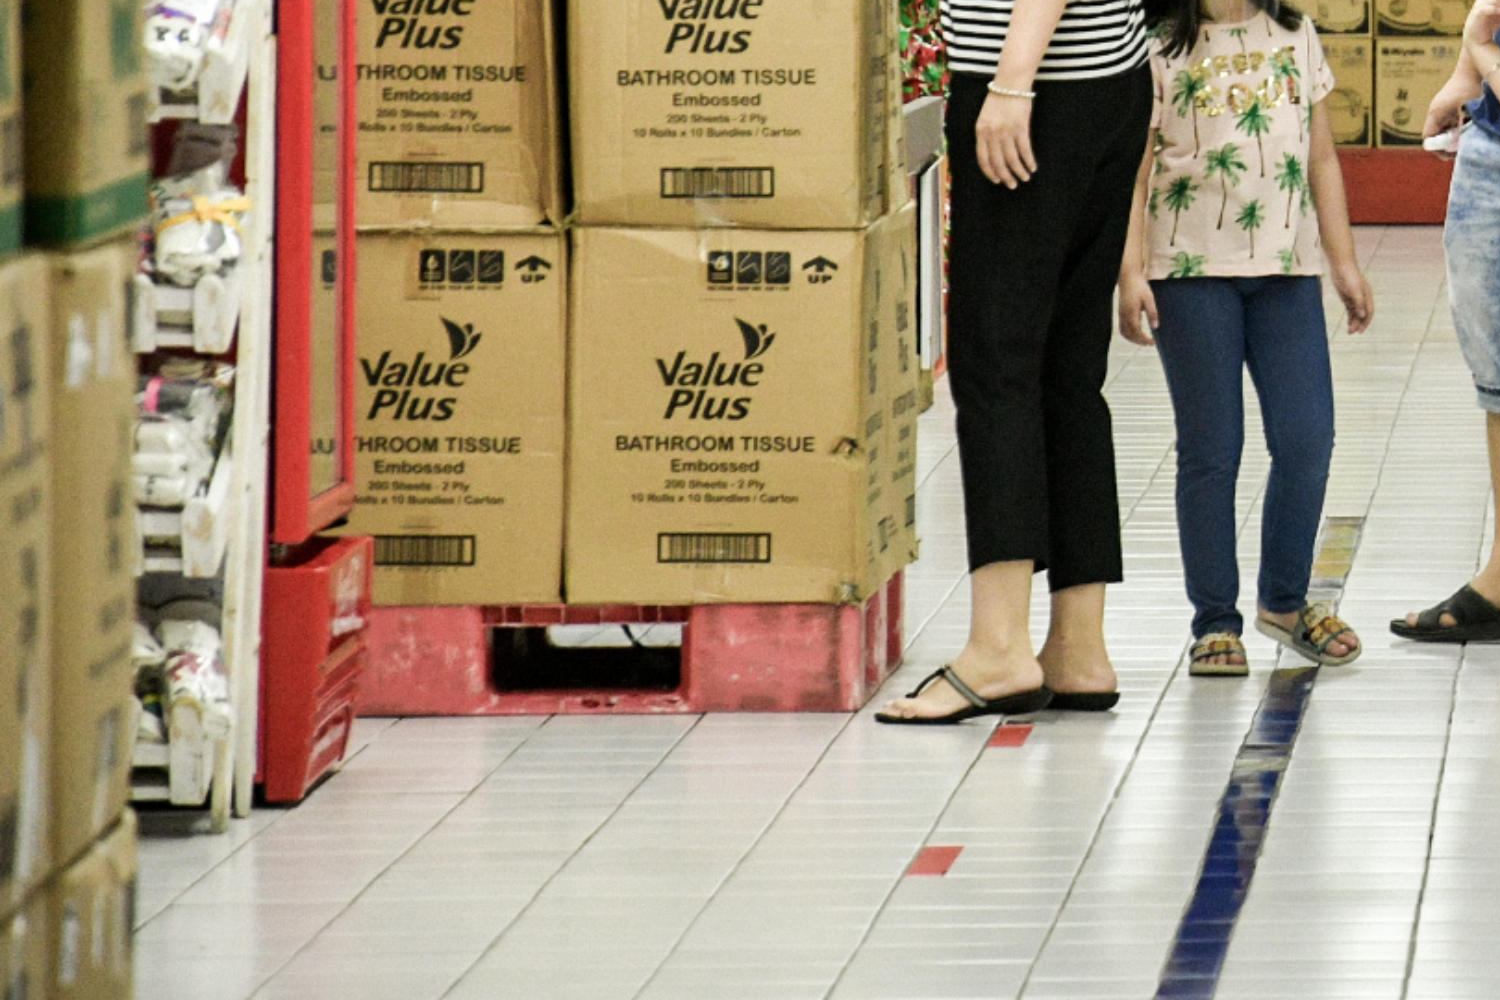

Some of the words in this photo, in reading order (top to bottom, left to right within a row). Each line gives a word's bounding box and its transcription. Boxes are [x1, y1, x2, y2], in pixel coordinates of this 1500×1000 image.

[375, 17, 464, 50] Plus
[664, 22, 752, 54] Plus
[355, 64, 447, 81] THROOM
[452, 65, 527, 82] TISSUE
[617, 69, 736, 87] BATHROOM
[741, 68, 817, 86] TISSUE
[382, 87, 473, 102] Embossed
[672, 92, 762, 107] Embossed
[690, 113, 730, 124] Sheets
[740, 113, 747, 124] 2
[749, 113, 768, 126] Ply
[633, 128, 647, 138] 10
[649, 127, 678, 138] Rolls
[690, 127, 704, 138] 10
[706, 127, 753, 138] Bundles
[762, 126, 801, 137] Carton
[520, 273, 546, 284] UP
[807, 273, 833, 285] UP
[360, 350, 470, 387] Value
[655, 350, 764, 387] Value
[367, 388, 457, 421] Plus
[663, 388, 752, 421] Plus
[444, 436, 522, 454] TISSUE
[615, 435, 735, 452] BATHROOM
[740, 435, 816, 452] TISSUE
[373, 460, 466, 475] Embossed
[670, 458, 760, 473] Embossed
[392, 481, 432, 492] Sheets
[452, 481, 471, 494] Ply
[688, 479, 728, 490] Sheets
[737, 479, 745, 490] 2
[747, 479, 766, 492] Ply
[407, 494, 455, 506] Bundles
[631, 494, 645, 504] 10
[688, 493, 702, 504] 10
[704, 493, 750, 504] Bundles
[760, 494, 800, 505] Carton
